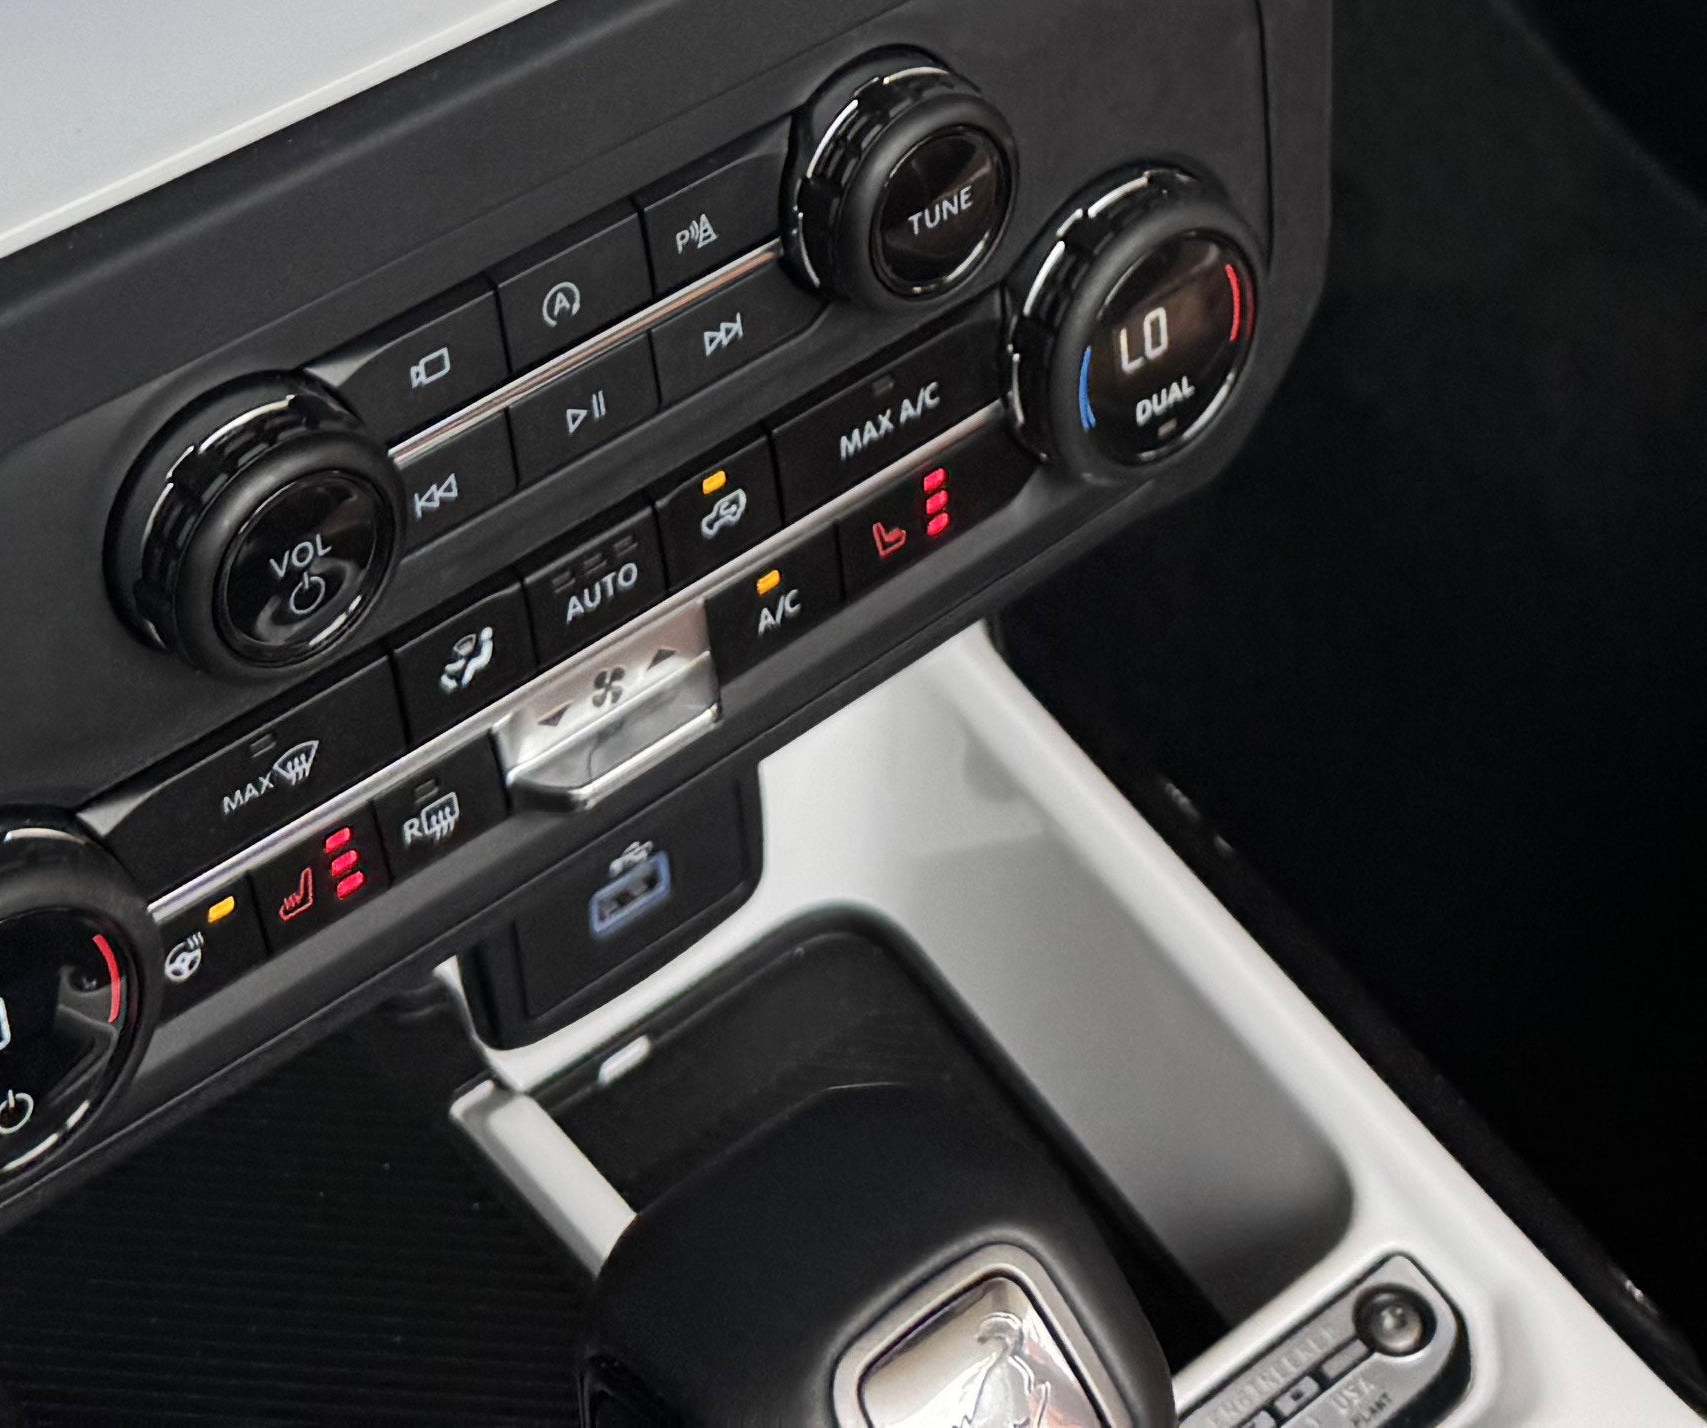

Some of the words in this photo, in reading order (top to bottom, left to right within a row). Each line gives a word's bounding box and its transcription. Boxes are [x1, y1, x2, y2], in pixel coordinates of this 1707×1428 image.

[908, 187, 974, 235] TUNE
[840, 408, 893, 459] MAX
[899, 382, 940, 426] A/C
[1137, 377, 1194, 426] DUAL
[270, 534, 332, 579] VOL
[566, 563, 639, 623] AUTO
[758, 588, 801, 637] A/C
[223, 774, 273, 816] MAX
[404, 817, 423, 846] R
